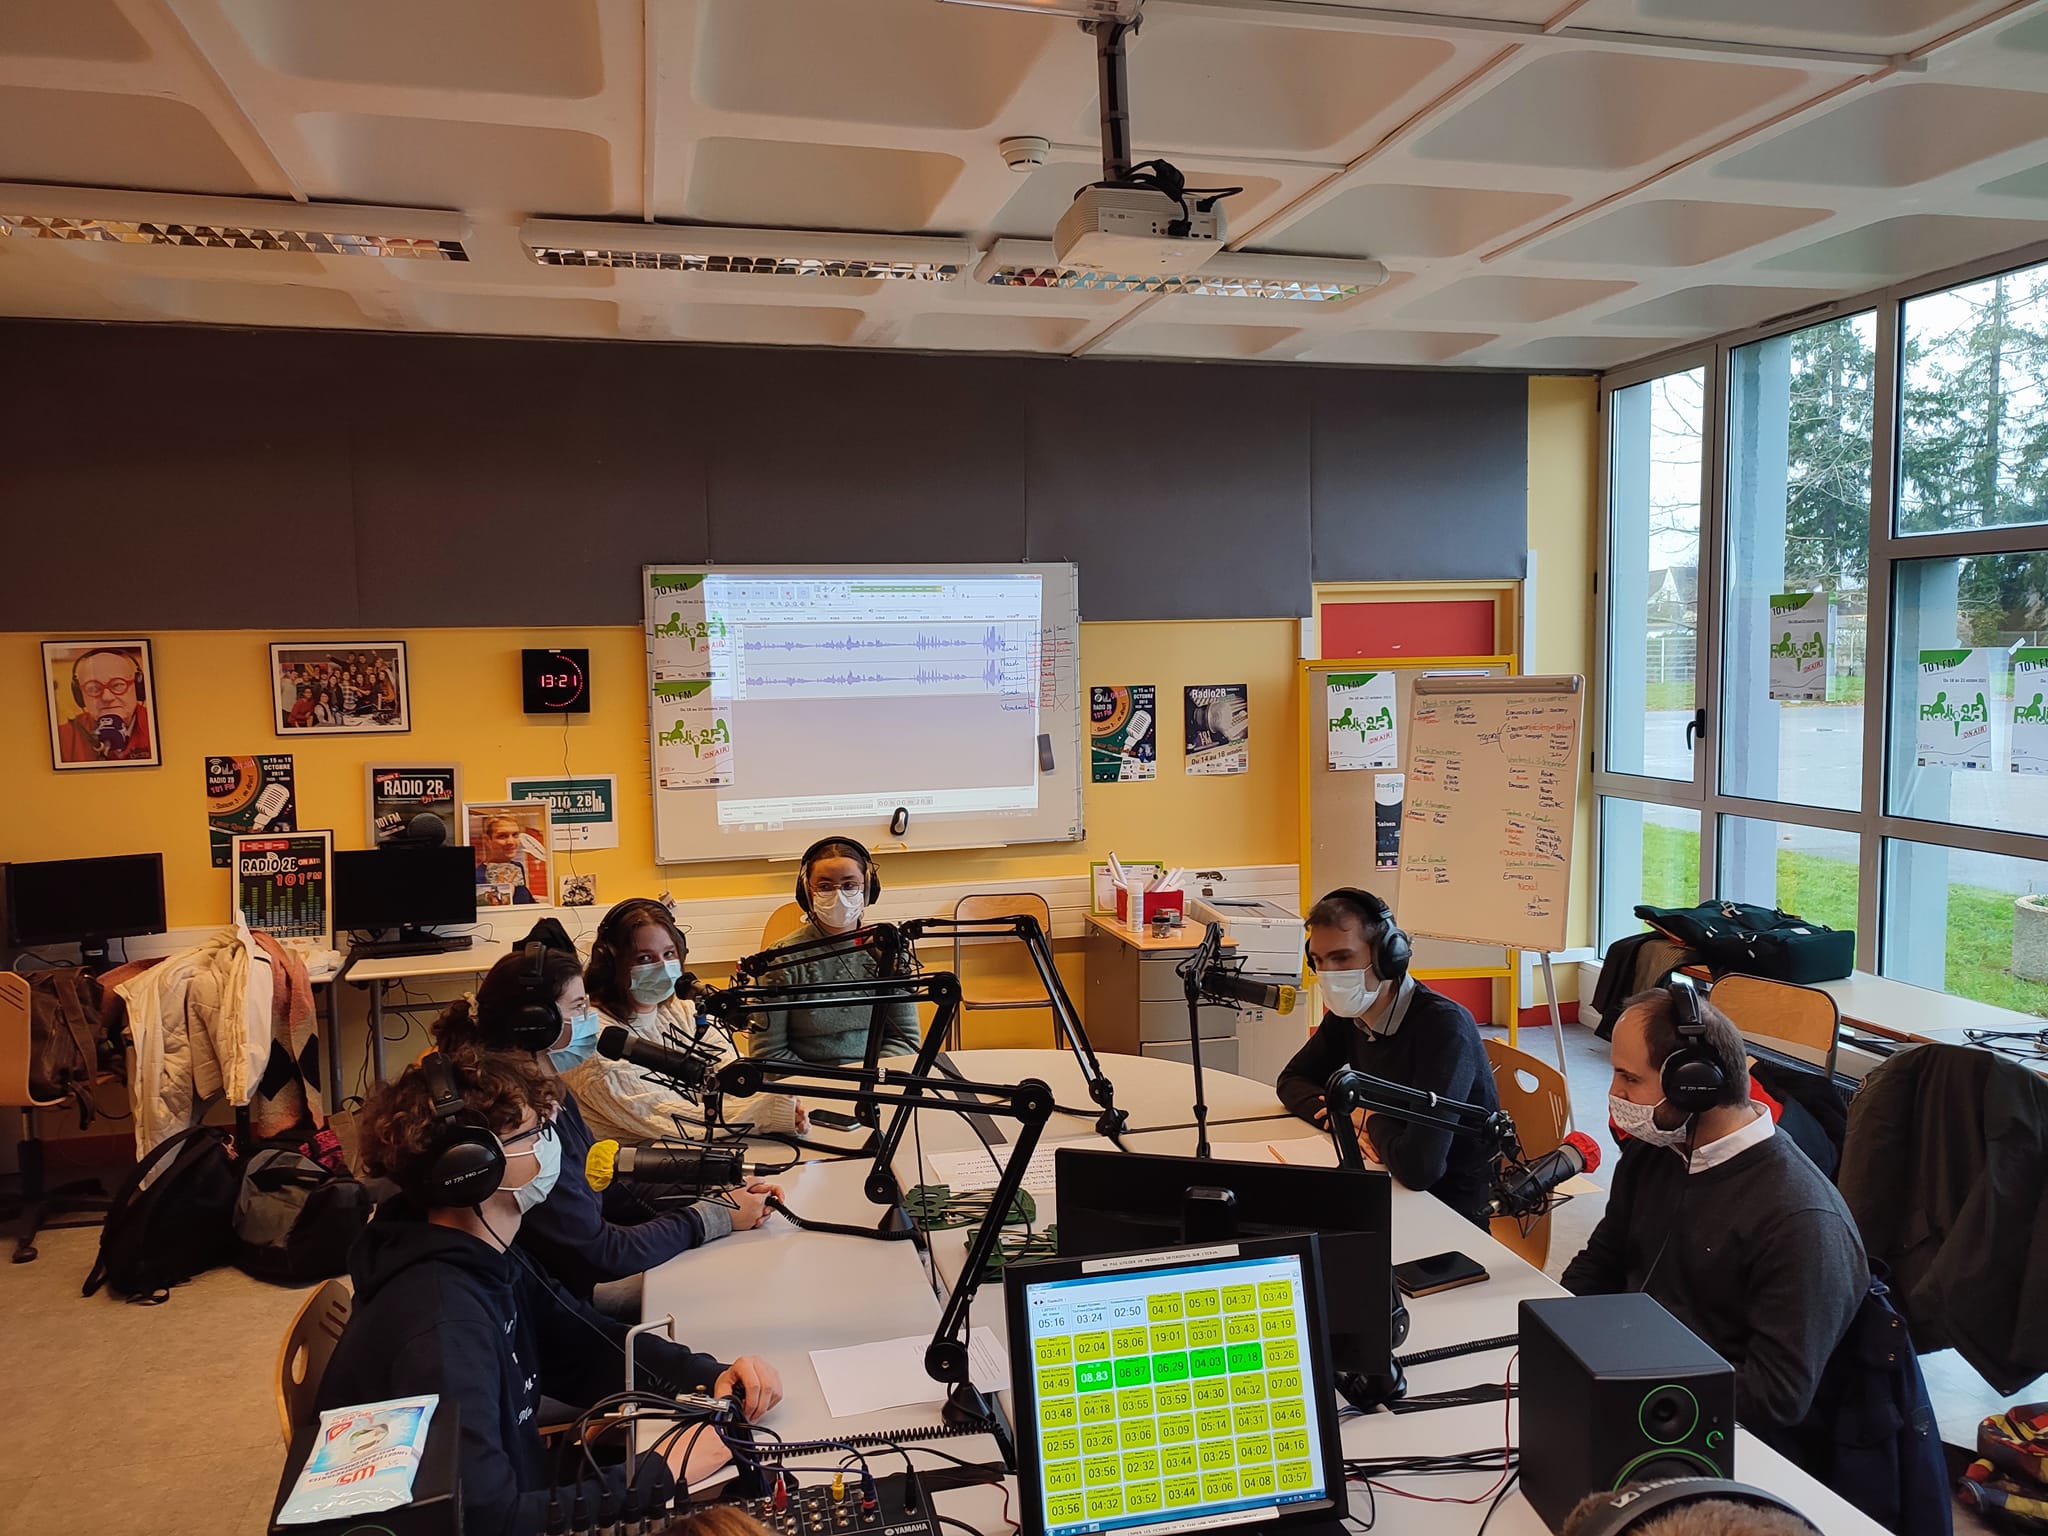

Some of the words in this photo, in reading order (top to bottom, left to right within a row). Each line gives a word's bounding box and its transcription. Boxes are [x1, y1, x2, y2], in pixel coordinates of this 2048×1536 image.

[656, 586, 673, 596] 101
[674, 582, 689, 592] FM
[1772, 606, 1786, 616] 101
[1787, 602, 1799, 612] FM
[1923, 663, 1940, 673] 101
[1943, 658, 1956, 668] FM
[2019, 662, 2037, 673] 101
[541, 674, 577, 688] 13:21
[1192, 688, 1226, 699] Radio2B
[1331, 682, 1348, 693] 101
[660, 694, 677, 704] 101
[678, 690, 693, 700] FM
[1192, 758, 1200, 766] Du
[384, 780, 423, 796] RADIO
[427, 780, 444, 795] 2B
[577, 796, 592, 807] 2B
[376, 818, 389, 829] 101
[389, 812, 402, 825] FM
[242, 858, 281, 873] RADIO
[281, 857, 298, 872] 2B
[276, 874, 306, 887] 101
[1189, 1297, 1216, 1308] 05:19
[1226, 1295, 1252, 1306] 04:37
[1263, 1292, 1288, 1302] 03:49
[1114, 1306, 1141, 1318] 02:50
[1152, 1304, 1179, 1315] 04:10
[1038, 1318, 1065, 1329] 05:16
[1076, 1313, 1102, 1324] 03:24
[1229, 1324, 1255, 1336] 03:43
[1265, 1319, 1291, 1331] 04:19
[1155, 1331, 1181, 1343] 19:01
[1192, 1330, 1217, 1341] 03:01
[1117, 1337, 1144, 1349] 58.06
[1041, 1348, 1067, 1359] 03:41
[1232, 1352, 1258, 1364] 07.18
[1269, 1350, 1295, 1362] 03:26
[1081, 1371, 1109, 1383] 08.83
[1120, 1366, 1146, 1378] 06.87
[1043, 1378, 1070, 1390] 04:49
[1272, 1378, 1298, 1390] 07:00
[1198, 1388, 1224, 1400] 04:30
[1236, 1385, 1261, 1397] 04:32
[1122, 1400, 1149, 1411] 03:55
[1160, 1394, 1187, 1406] 03:59
[1044, 1408, 1073, 1421] 03:48
[1084, 1404, 1111, 1416] 04:18
[1275, 1409, 1301, 1421] 04:46
[1201, 1420, 1226, 1432] 05:14
[1239, 1416, 1264, 1427] 04:31
[1125, 1430, 1152, 1442] 03:06
[1164, 1425, 1190, 1437] 03:09
[1047, 1440, 1075, 1452] 02:55
[1086, 1436, 1113, 1448] 03:26
[1278, 1440, 1305, 1453] 04:16
[1204, 1450, 1231, 1462] 03:25
[1241, 1445, 1268, 1457] 04:02
[1127, 1460, 1155, 1473] 02:32
[1166, 1456, 1192, 1468] 03:44
[1088, 1466, 1116, 1479] 03:56
[1283, 1472, 1307, 1484] 03:57
[1050, 1473, 1076, 1485] 04:01
[1244, 1476, 1271, 1489] 04:08
[1168, 1488, 1196, 1500] 03:44
[1207, 1482, 1233, 1495] 03:06
[1091, 1499, 1119, 1512] 04:32
[1130, 1494, 1157, 1506] 03:52
[1052, 1503, 1080, 1517] 03:56
[895, 1523, 929, 1535] YAMAHA
